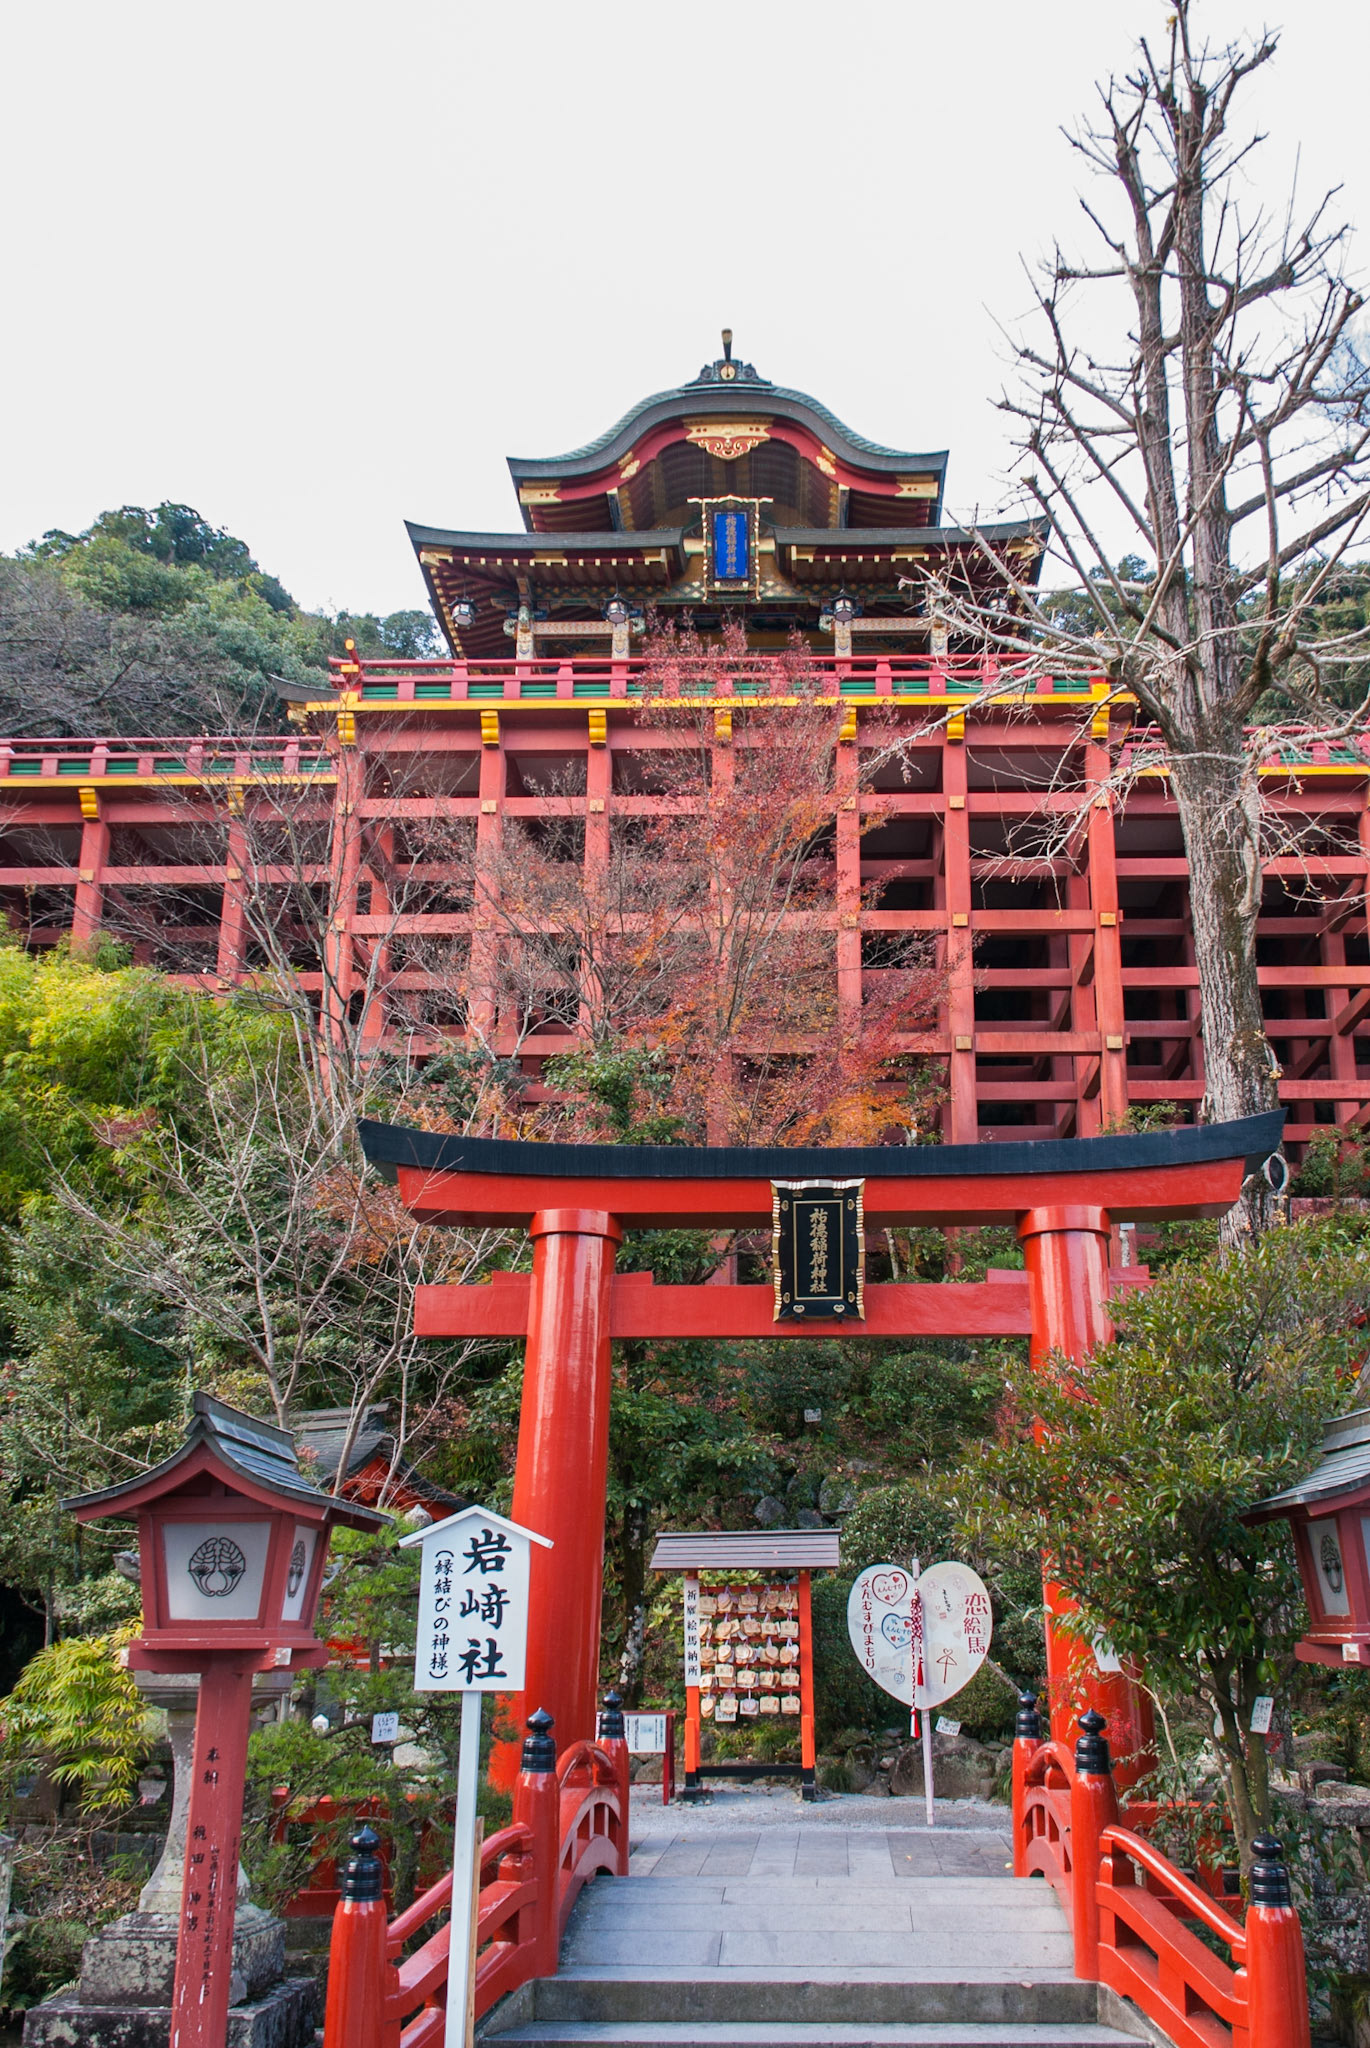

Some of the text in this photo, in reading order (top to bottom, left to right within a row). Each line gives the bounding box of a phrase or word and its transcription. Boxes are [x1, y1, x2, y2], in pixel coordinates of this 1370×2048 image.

[809, 1208, 828, 1294] 祐徳稲荷神社
[862, 1578, 875, 1669] えんむすびまもり
[963, 1593, 988, 1654] 恋絵馬
